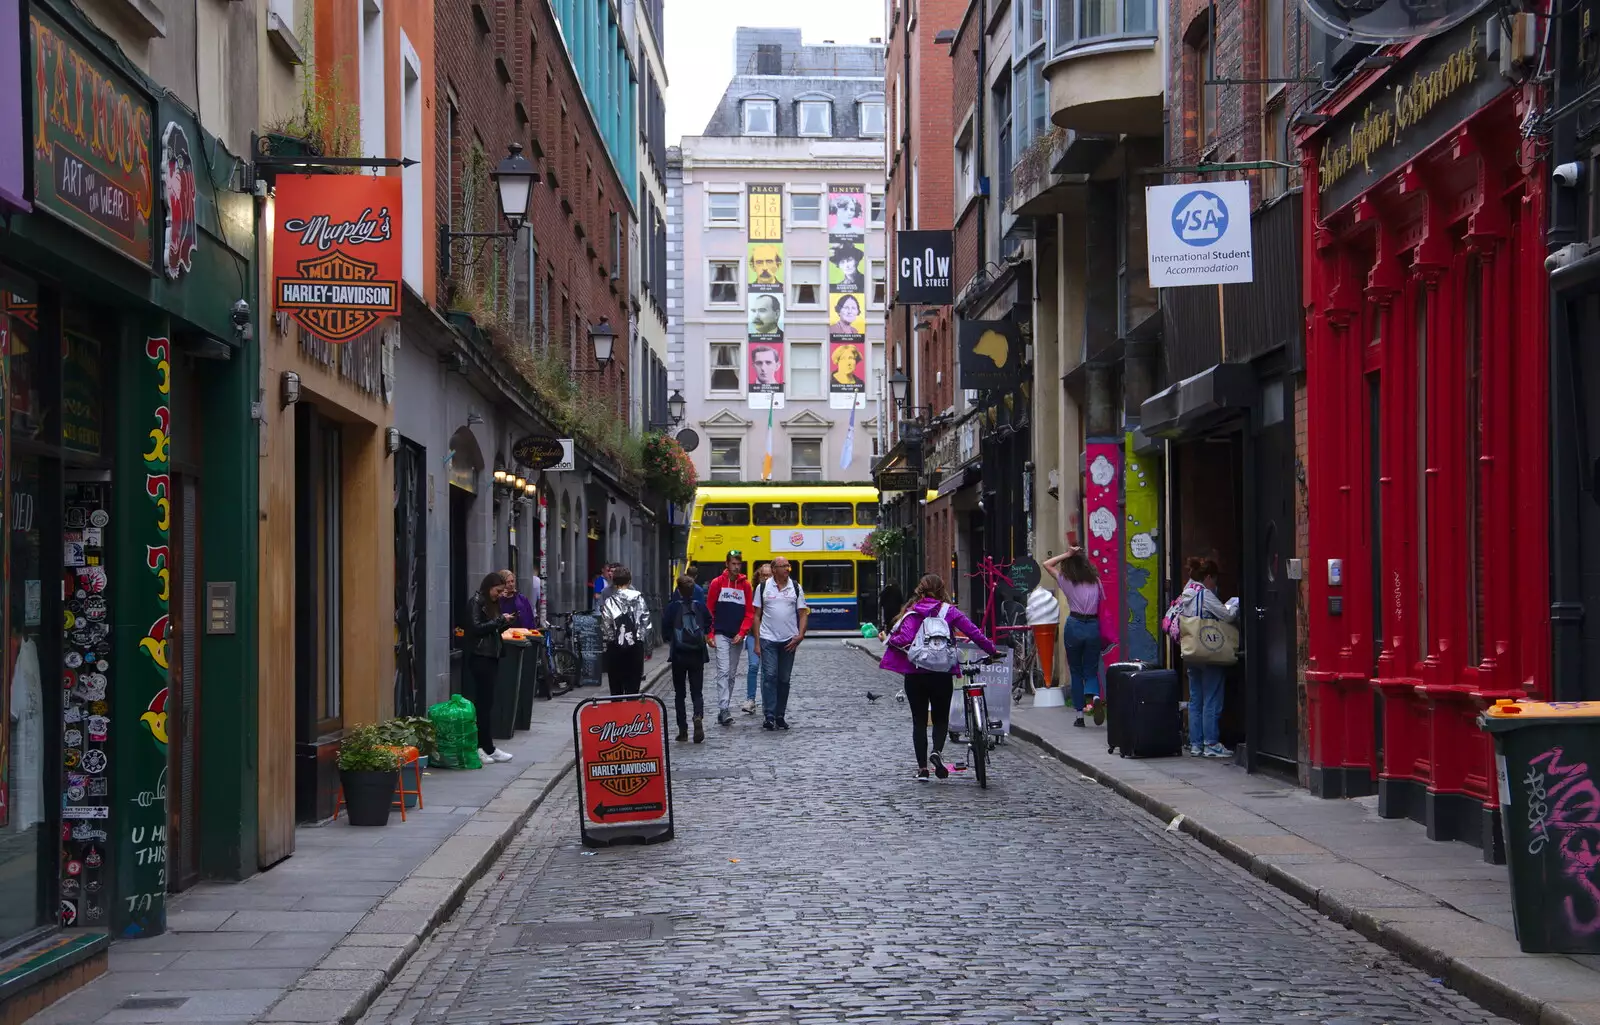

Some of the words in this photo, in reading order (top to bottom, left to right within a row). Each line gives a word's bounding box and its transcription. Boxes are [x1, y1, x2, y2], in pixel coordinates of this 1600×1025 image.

[30, 15, 151, 219] TATTOOS
[62, 156, 83, 197] ART
[285, 207, 391, 250] Murphy's
[1151, 251, 1210, 263] International
[1212, 249, 1251, 260] Student
[309, 259, 365, 280] MOTOR
[901, 247, 950, 288] CROW
[1165, 263, 1239, 275] Accommodation
[925, 278, 949, 287] STREET
[283, 284, 390, 305] HARLEY-DAVIDSON
[308, 309, 365, 333] CYCLES
[589, 712, 654, 743] Murphy's
[606, 749, 641, 761] MOTOR
[591, 761, 656, 777] HARLEY-DAVIDSON
[607, 777, 641, 793] CYCLES
[131, 826, 146, 844] U
